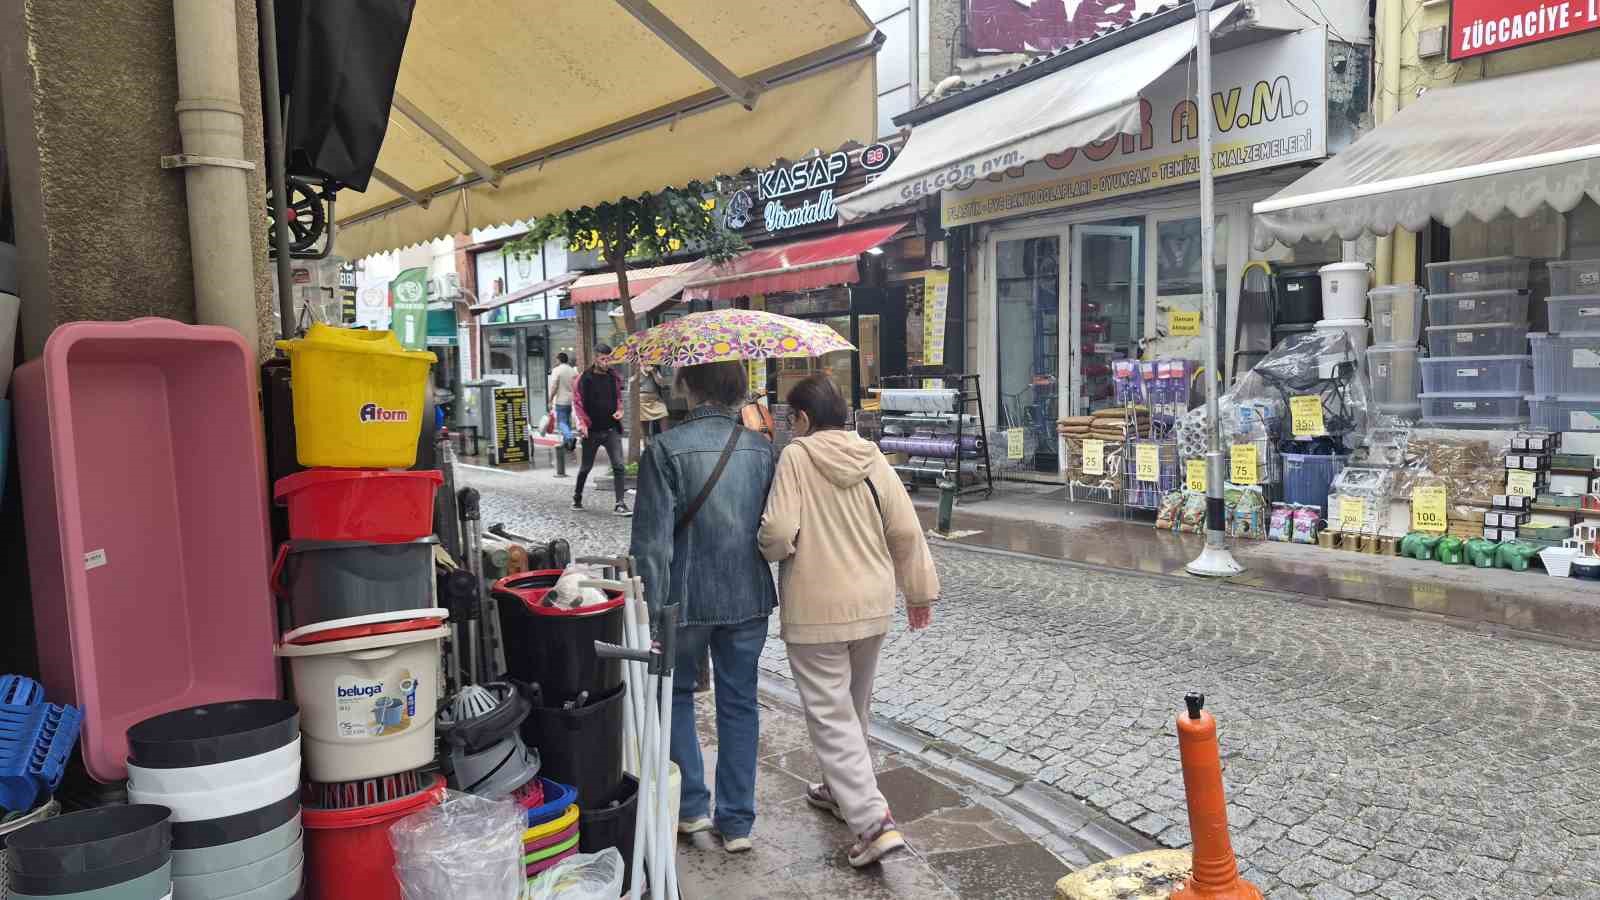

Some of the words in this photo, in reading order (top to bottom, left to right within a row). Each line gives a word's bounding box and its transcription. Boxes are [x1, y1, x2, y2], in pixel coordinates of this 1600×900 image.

[1462, 3, 1569, 51] ZÜCCACİYE
[1100, 166, 1152, 192] OYUNCAK
[1217, 128, 1311, 168] MALZEMELERİ
[757, 151, 847, 200] KASAP
[900, 163, 975, 199] GEL-GÖR
[1086, 456, 1096, 466] 25
[1138, 463, 1152, 473] 175
[1235, 465, 1248, 476] 75
[1192, 481, 1203, 490] 50
[1416, 511, 1436, 522] 100
[337, 684, 382, 698] beluga
